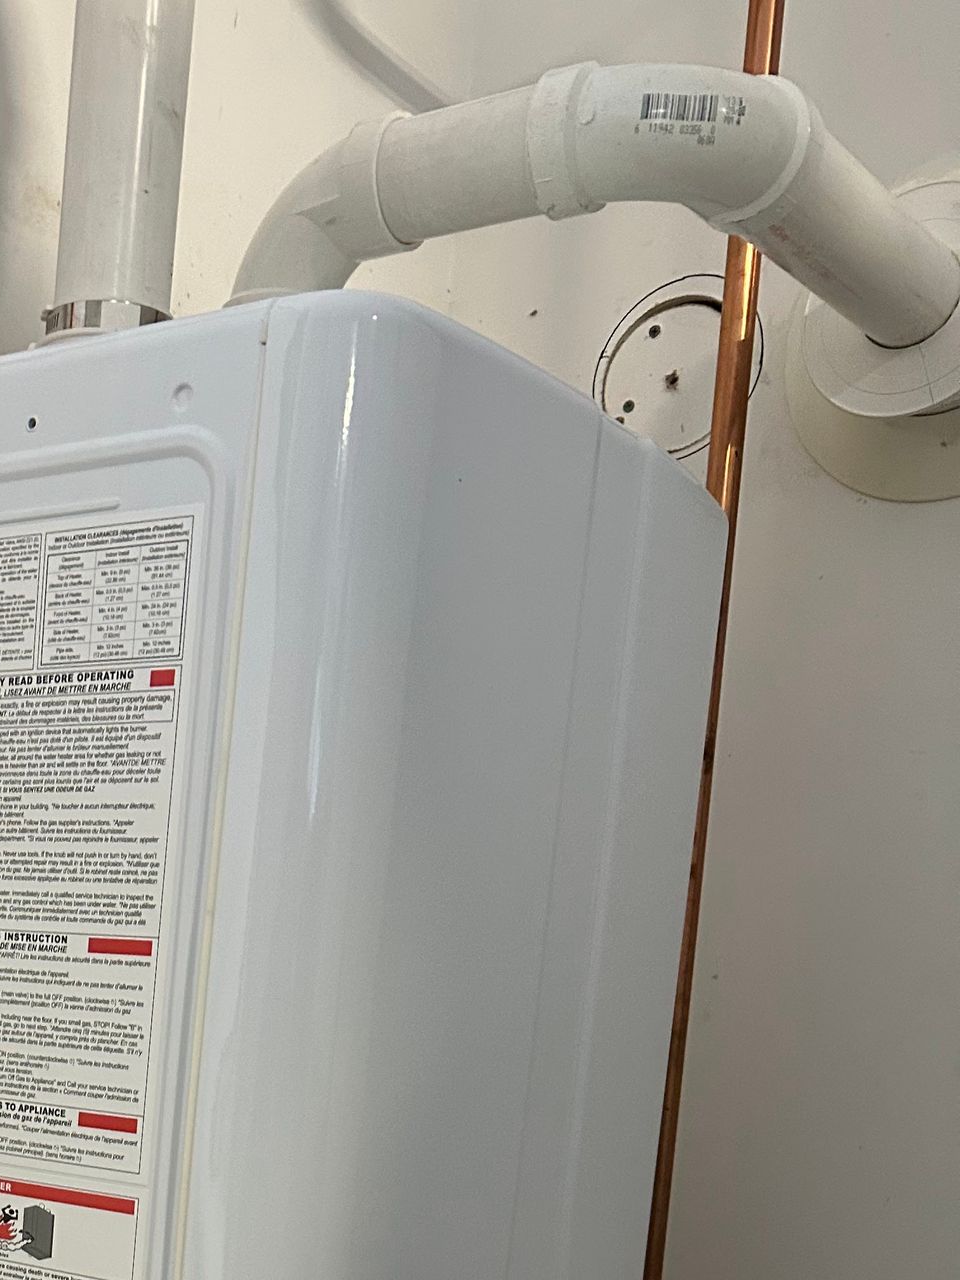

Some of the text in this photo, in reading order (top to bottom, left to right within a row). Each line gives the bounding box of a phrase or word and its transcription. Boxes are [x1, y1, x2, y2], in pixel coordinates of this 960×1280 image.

[8, 675, 33, 686] READ
[36, 673, 73, 684] BEFORE
[76, 669, 134, 682] OPERATING
[3, 687, 22, 697] LISEZ
[23, 686, 46, 696] AVANT
[46, 685, 57, 694] DE
[57, 684, 86, 694] METTRE
[88, 683, 99, 692] EN
[99, 681, 131, 692] MARCHE
[120, 695, 145, 705] property
[3, 931, 68, 944] INSTRUCTION
[0, 941, 9, 950] DE
[9, 942, 25, 951] MISE
[27, 943, 37, 952] EN
[37, 943, 67, 953] MARCHE
[4, 1101, 16, 1111] TO
[17, 1103, 66, 1118] APPLIANCE
[12, 1112, 20, 1120] de
[20, 1115, 32, 1123] gaz
[33, 1115, 41, 1123] de
[27, 1268, 43, 1276] death
